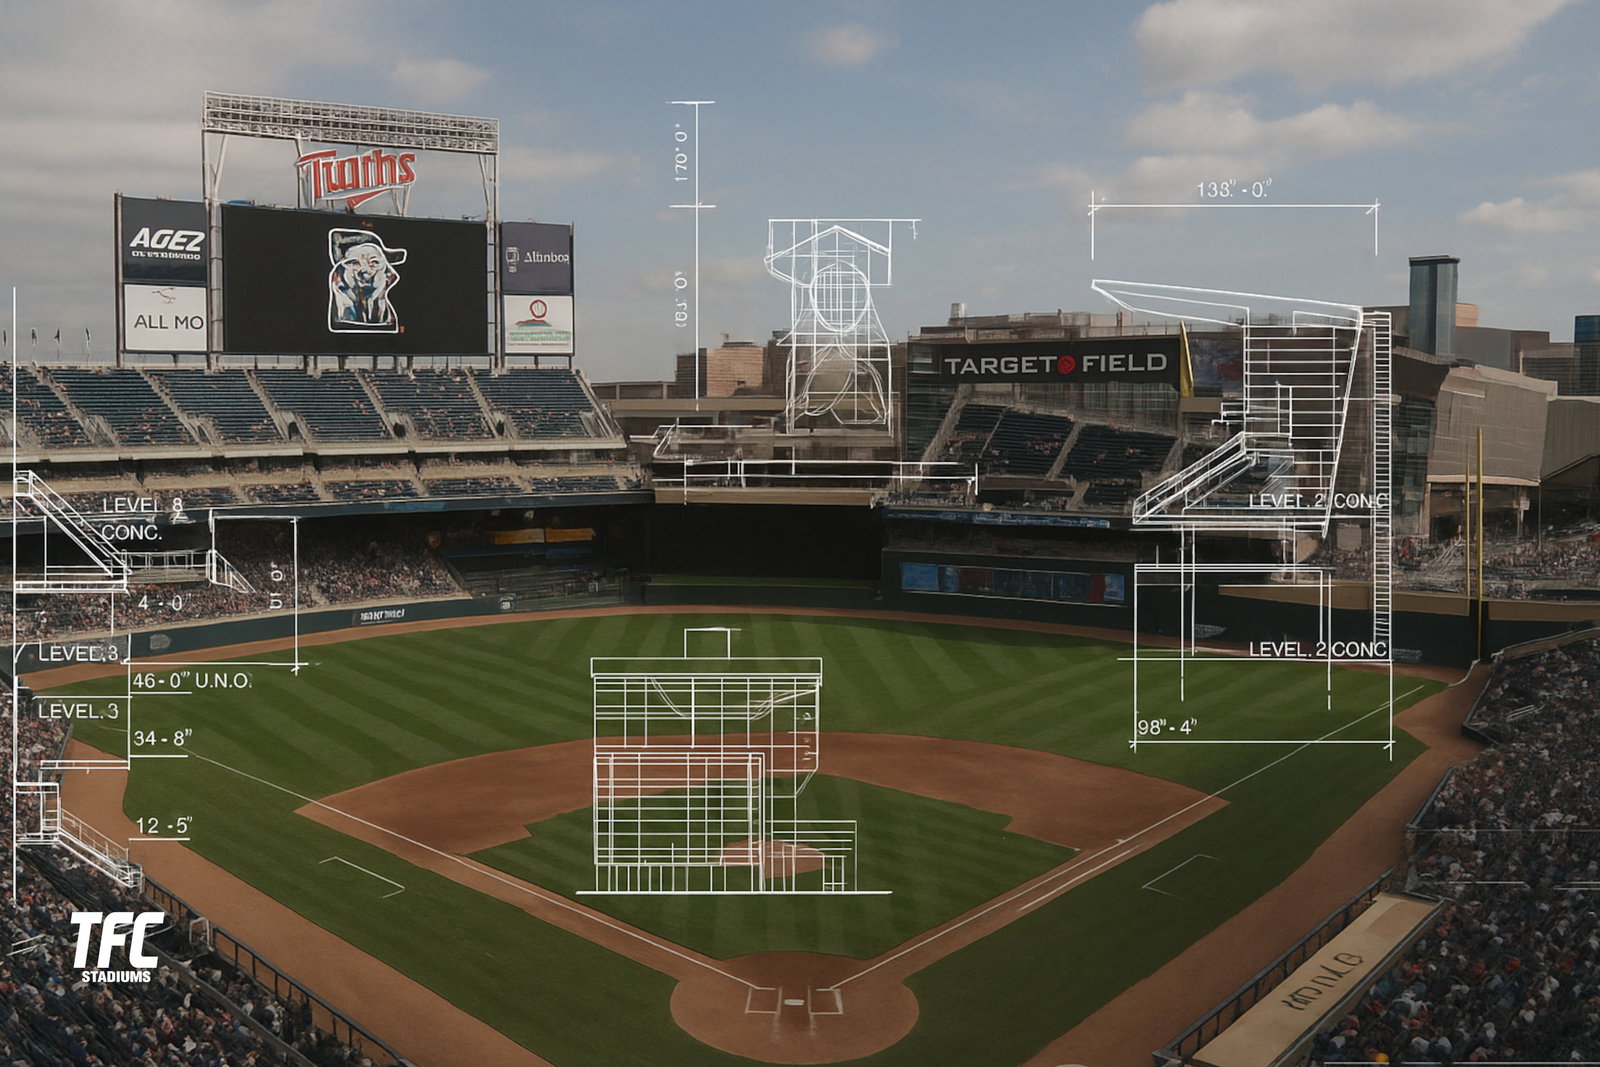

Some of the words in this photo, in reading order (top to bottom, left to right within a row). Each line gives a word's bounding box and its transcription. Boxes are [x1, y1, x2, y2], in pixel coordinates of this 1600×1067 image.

[134, 314, 169, 329] ALL
[174, 315, 205, 330] MO
[944, 356, 1058, 375] TARGET
[1082, 353, 1168, 372] FIELD
